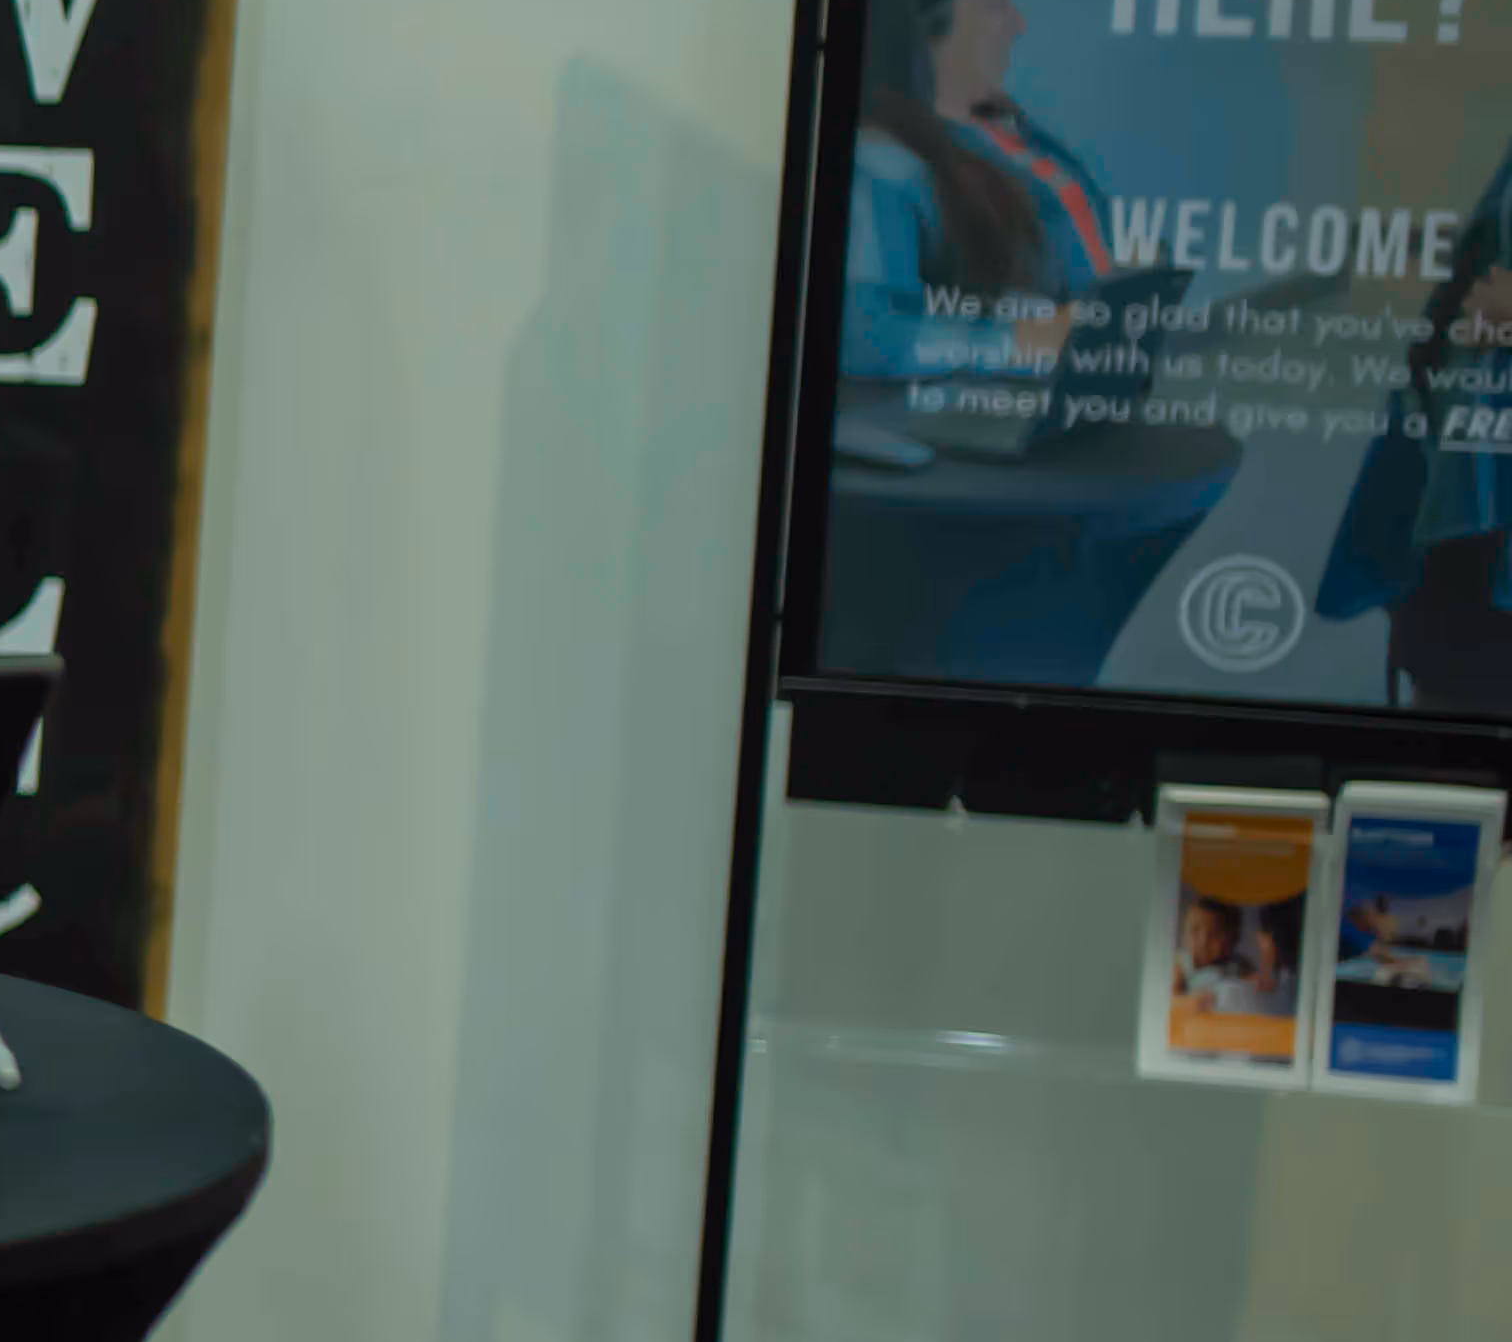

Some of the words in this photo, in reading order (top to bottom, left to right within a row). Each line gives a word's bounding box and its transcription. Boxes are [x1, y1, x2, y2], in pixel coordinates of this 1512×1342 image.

[1110, 196, 1459, 281] WELCOME
[925, 283, 981, 316] We
[995, 295, 1056, 321] are
[1069, 300, 1111, 327] so
[1124, 292, 1210, 341] glad
[1226, 298, 1300, 334] that
[1315, 302, 1435, 347] you've
[1071, 342, 1149, 374] with
[1166, 355, 1202, 378] us
[1352, 354, 1410, 385] We
[909, 380, 945, 411] to
[960, 386, 1051, 418] meet
[1067, 394, 1130, 429] you
[1145, 388, 1216, 425] and
[1227, 401, 1309, 438] give
[1323, 409, 1387, 446] you
[1403, 412, 1429, 438] a
